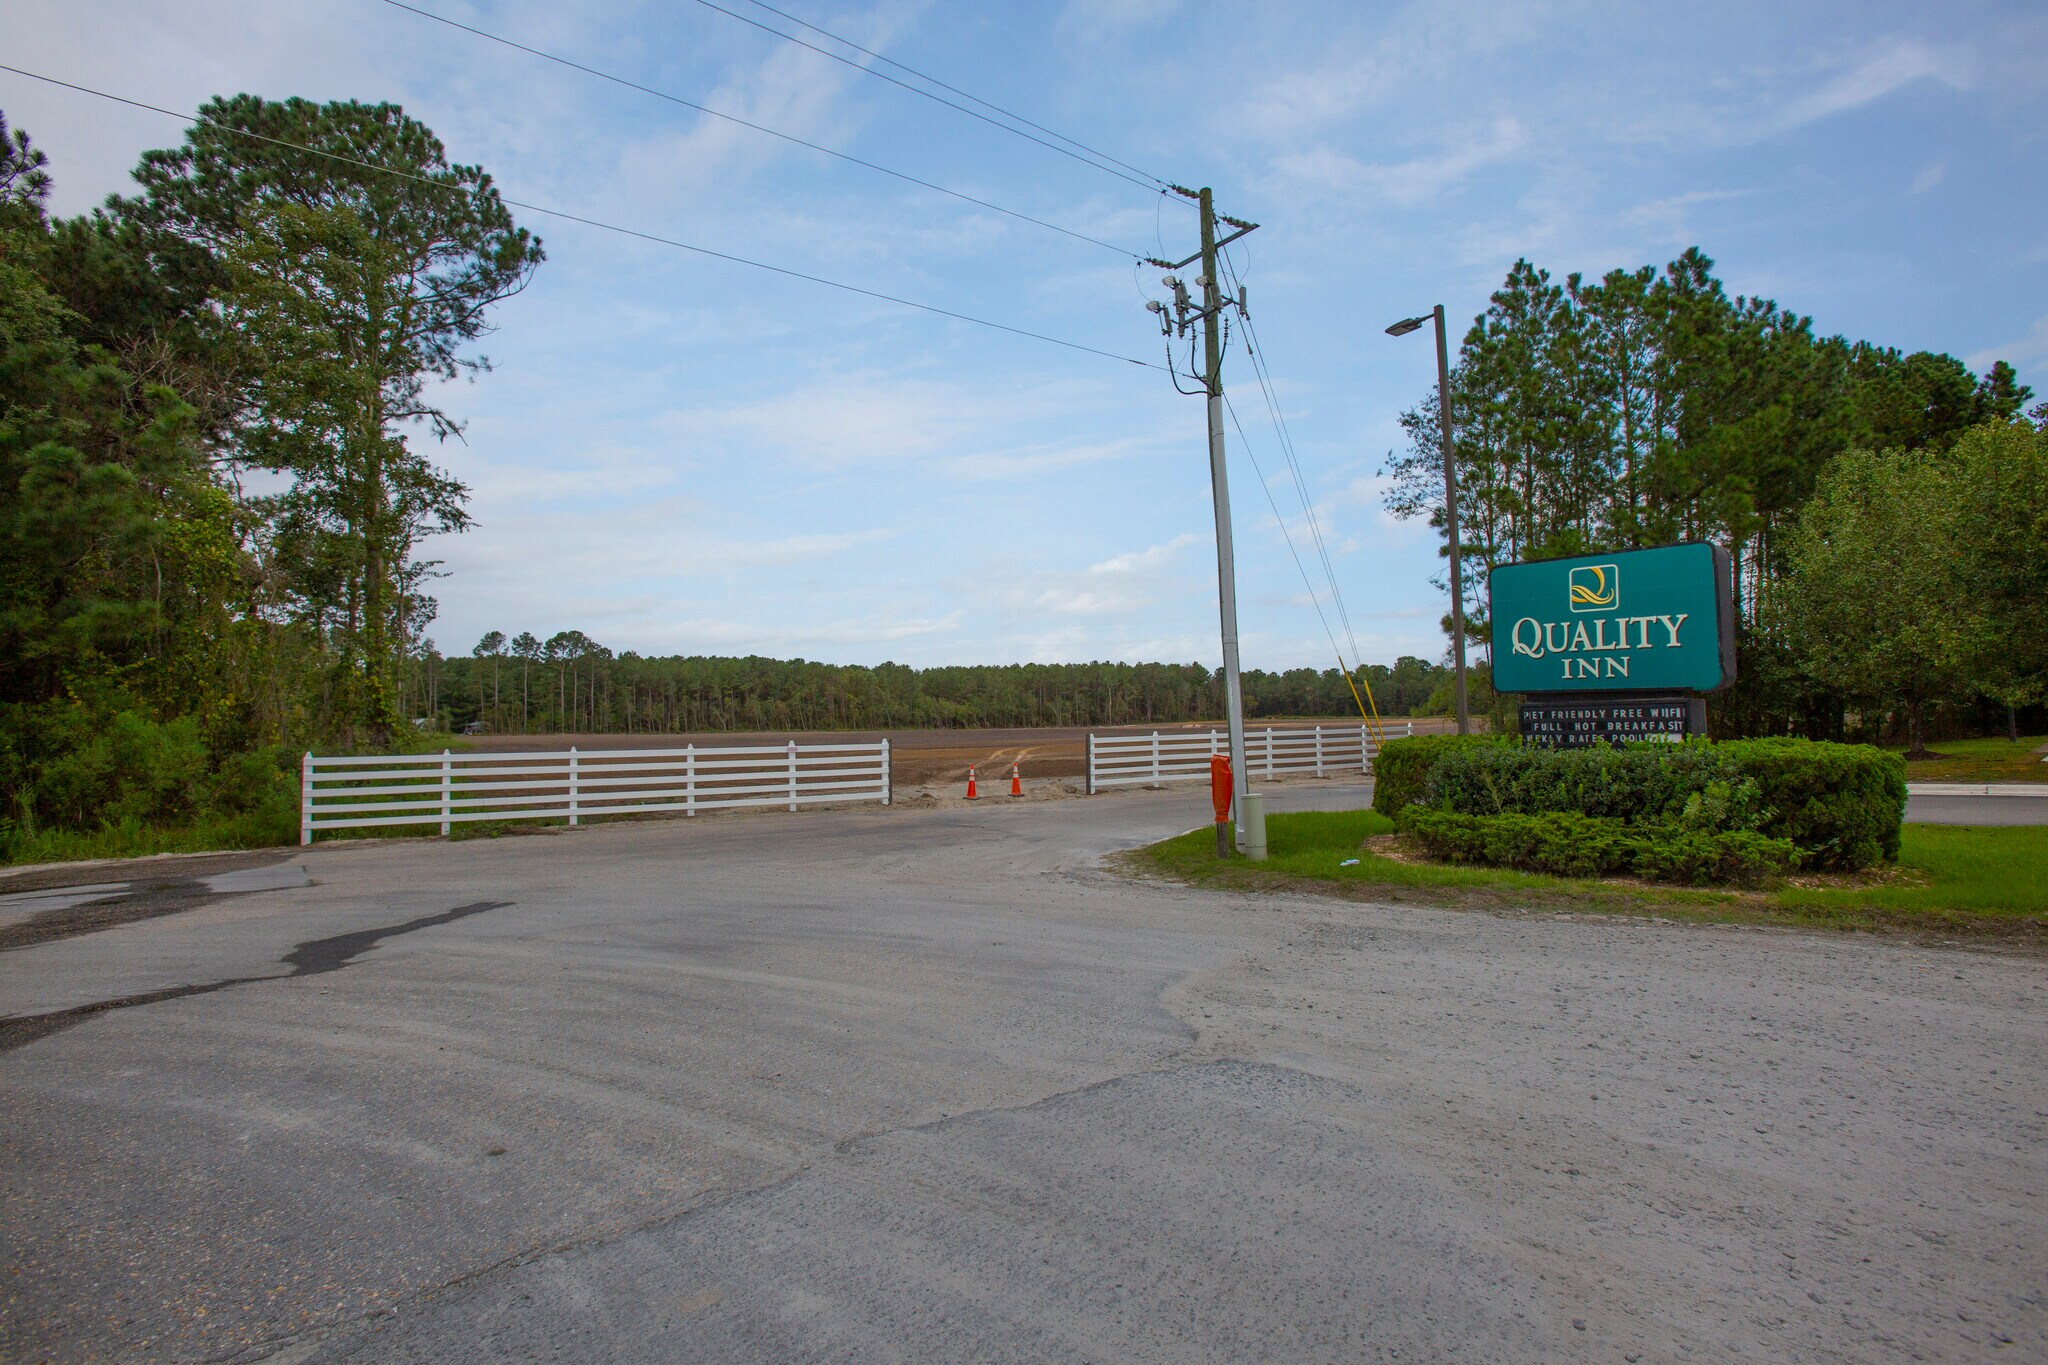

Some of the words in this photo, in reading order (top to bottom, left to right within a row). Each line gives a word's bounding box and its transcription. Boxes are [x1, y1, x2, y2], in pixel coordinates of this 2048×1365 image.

[1511, 613, 1689, 659] QUALITY
[1561, 656, 1631, 679] INN
[1523, 711, 1544, 719] PET
[1551, 710, 1606, 719] FRIENDLY
[1613, 708, 1643, 718] FREE
[1533, 722, 1562, 731] FULL
[1574, 722, 1597, 731] HOT
[1607, 720, 1684, 731] BREAKFAST
[1569, 734, 1605, 743] RATES
